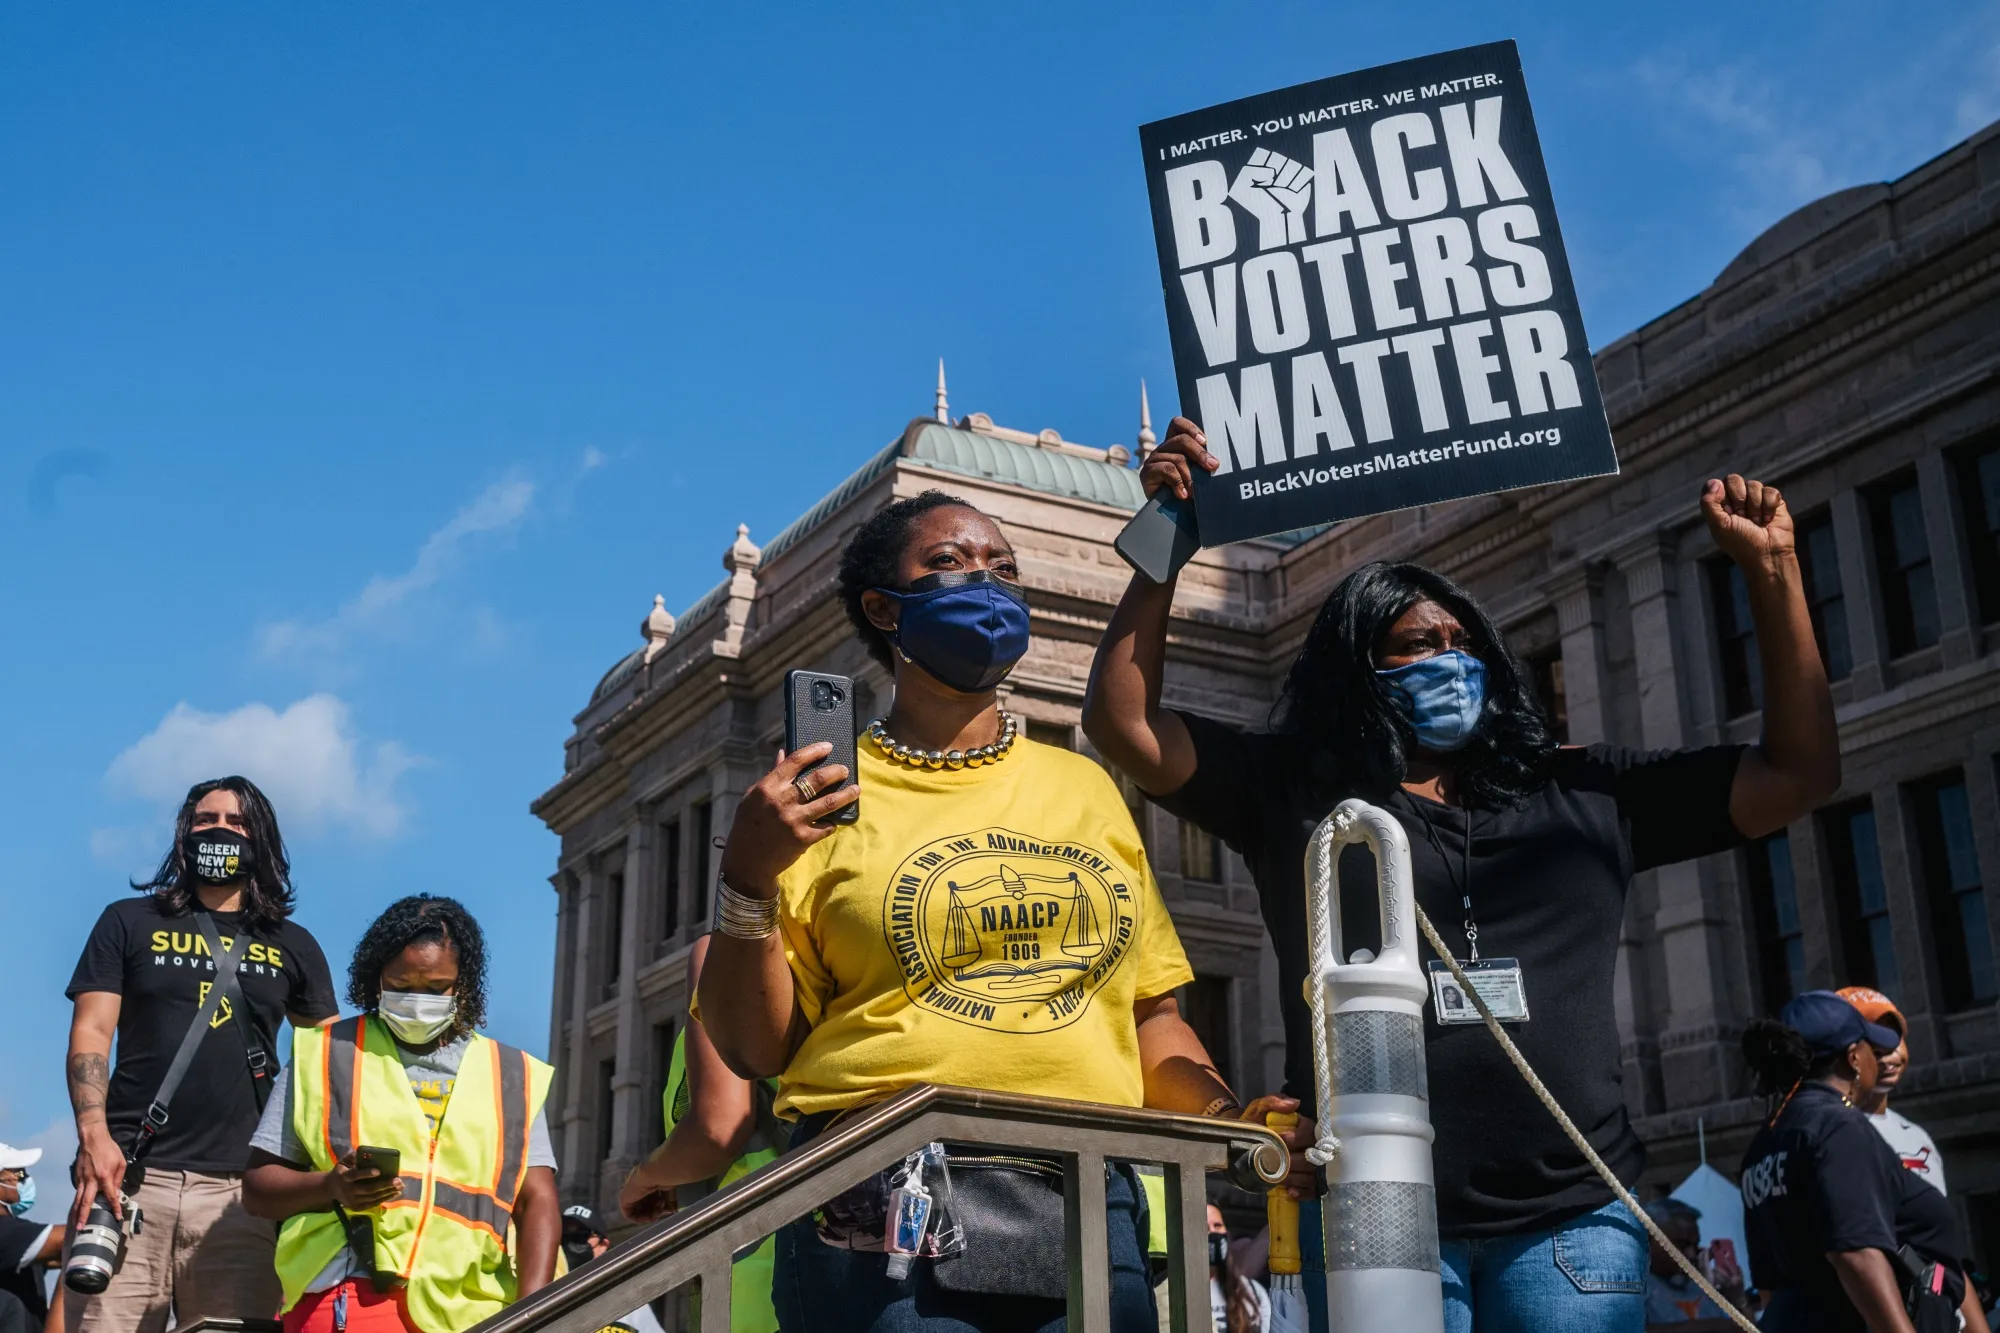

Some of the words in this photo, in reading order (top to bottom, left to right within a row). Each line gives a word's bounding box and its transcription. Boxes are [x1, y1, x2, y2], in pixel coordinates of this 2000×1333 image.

[1160, 148, 1166, 161] I
[1170, 129, 1248, 158] MATTER.
[1251, 116, 1294, 136] YOU
[1298, 98, 1379, 126] MATTER.
[1383, 89, 1416, 106] WE
[1420, 73, 1503, 99] MATTER.
[1180, 204, 1553, 367] VOTERS
[1196, 309, 1582, 476] MATTER
[1239, 426, 1561, 500] BlackVotersMatterFund.org
[197, 854, 226, 867] NEW
[198, 842, 240, 856] GREEN
[913, 851, 945, 873] FOR
[944, 837, 978, 854] THE
[986, 832, 1113, 875] ADVANCEMENT
[197, 865, 228, 878] DEAL
[1113, 883, 1131, 903] OF
[891, 873, 929, 986] ASSOCIATION
[980, 901, 1060, 932] NAACP
[150, 930, 283, 968] SUNSE
[154, 956, 278, 978] MOVEENT
[1002, 943, 1040, 960] 1909
[1093, 915, 1133, 984] COLORED
[918, 980, 996, 1022] NATIONAL
[1046, 981, 1085, 1021] PEOPLE
